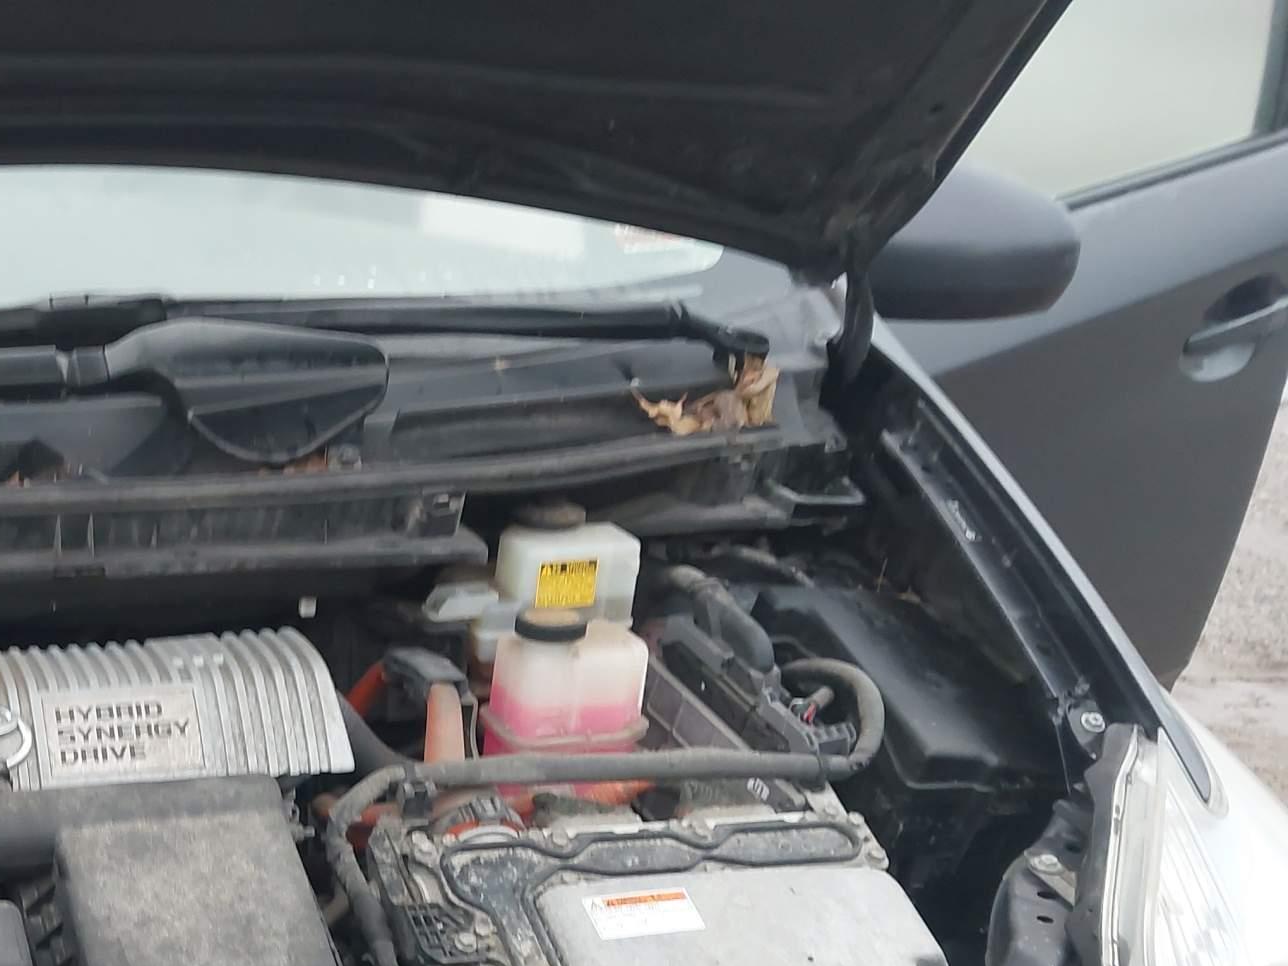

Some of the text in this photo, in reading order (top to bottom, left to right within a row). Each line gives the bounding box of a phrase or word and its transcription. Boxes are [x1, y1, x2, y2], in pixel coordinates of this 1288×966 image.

[54, 702, 163, 723] HYBRID
[57, 717, 189, 745] SYNERGY
[60, 744, 146, 764] DRIVE
